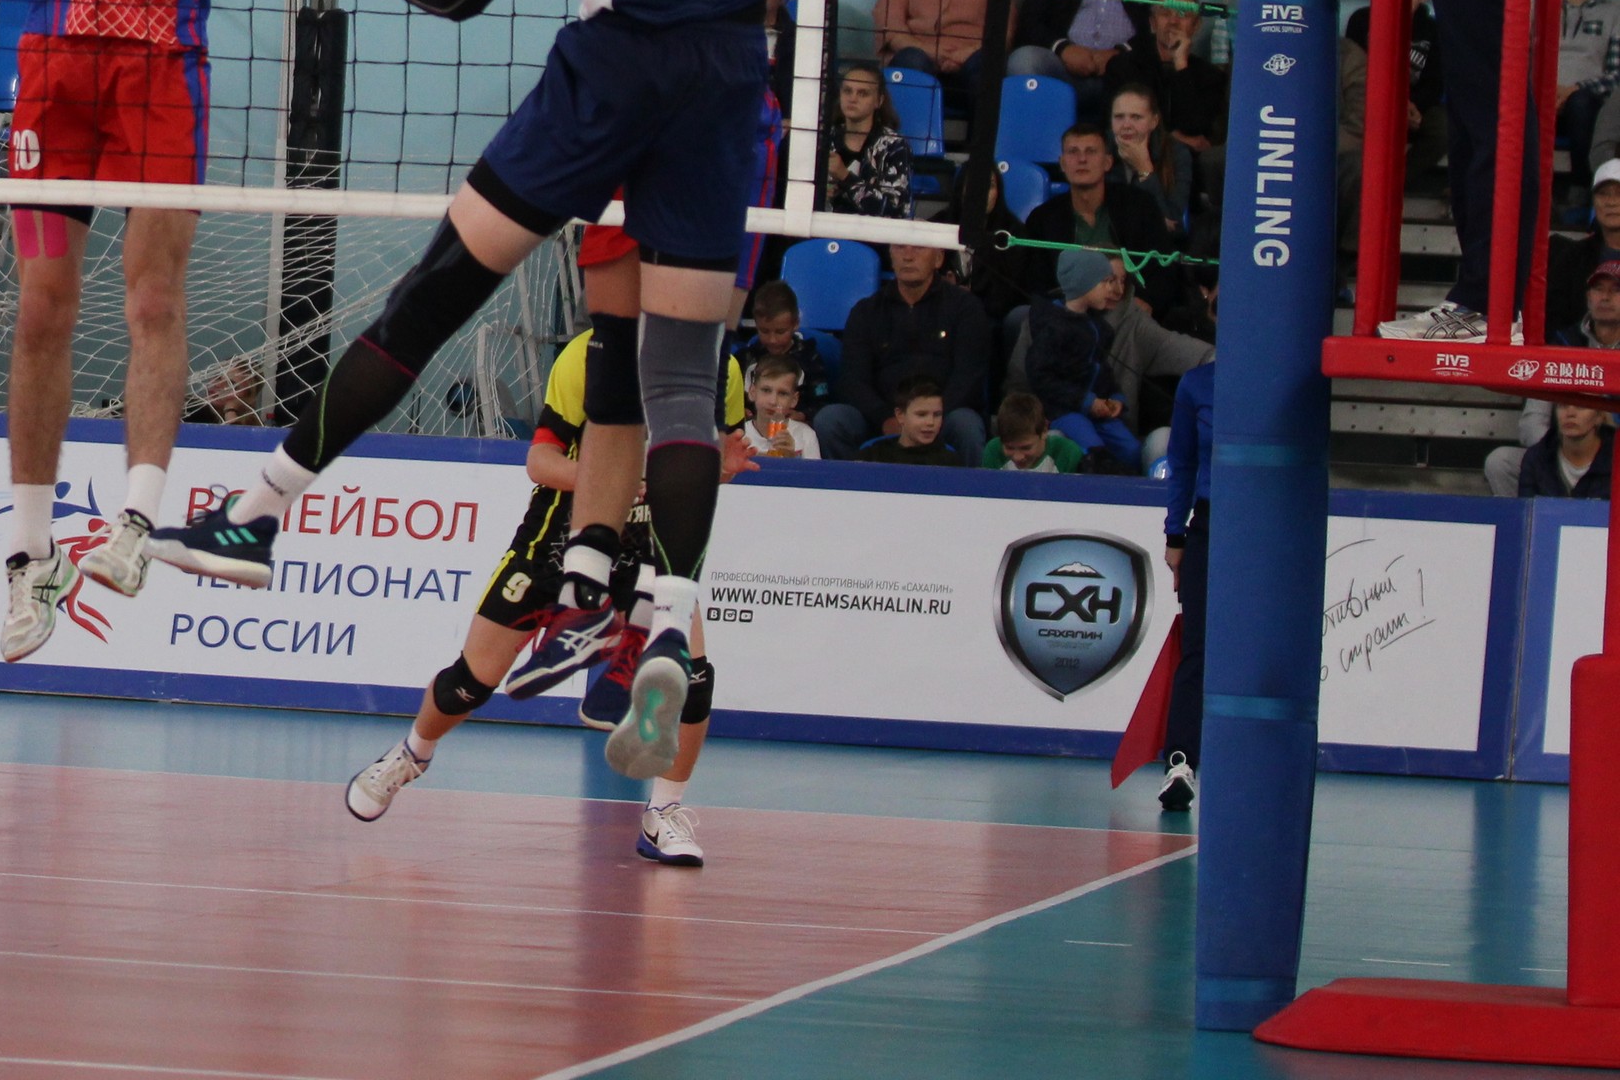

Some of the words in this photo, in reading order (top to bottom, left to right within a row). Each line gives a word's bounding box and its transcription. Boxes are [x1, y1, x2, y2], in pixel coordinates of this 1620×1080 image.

[1261, 4, 1304, 20] FIVB
[13, 129, 41, 171] 20
[1253, 105, 1296, 267] JINLING
[1436, 353, 1470, 368] FIVB
[1544, 361, 1605, 379] 金陵体育
[1543, 377, 1573, 386] JINLING
[1573, 378, 1605, 387] SPORTS
[186, 484, 479, 542] ВЕЙБОЛ
[502, 572, 532, 603] 9
[711, 571, 810, 586] ПРОФЕССИОНАЛЬНЫЙ
[811, 577, 874, 590] СПОРТИВНЫЙ
[875, 579, 900, 591] КЛУБ
[901, 581, 954, 595] «САХАЛИН»
[711, 587, 952, 615] WWW.ONETEAMSAKHALIN.RU
[169, 612, 357, 656] РОССИИ
[1038, 628, 1103, 640] САХАЛИН
